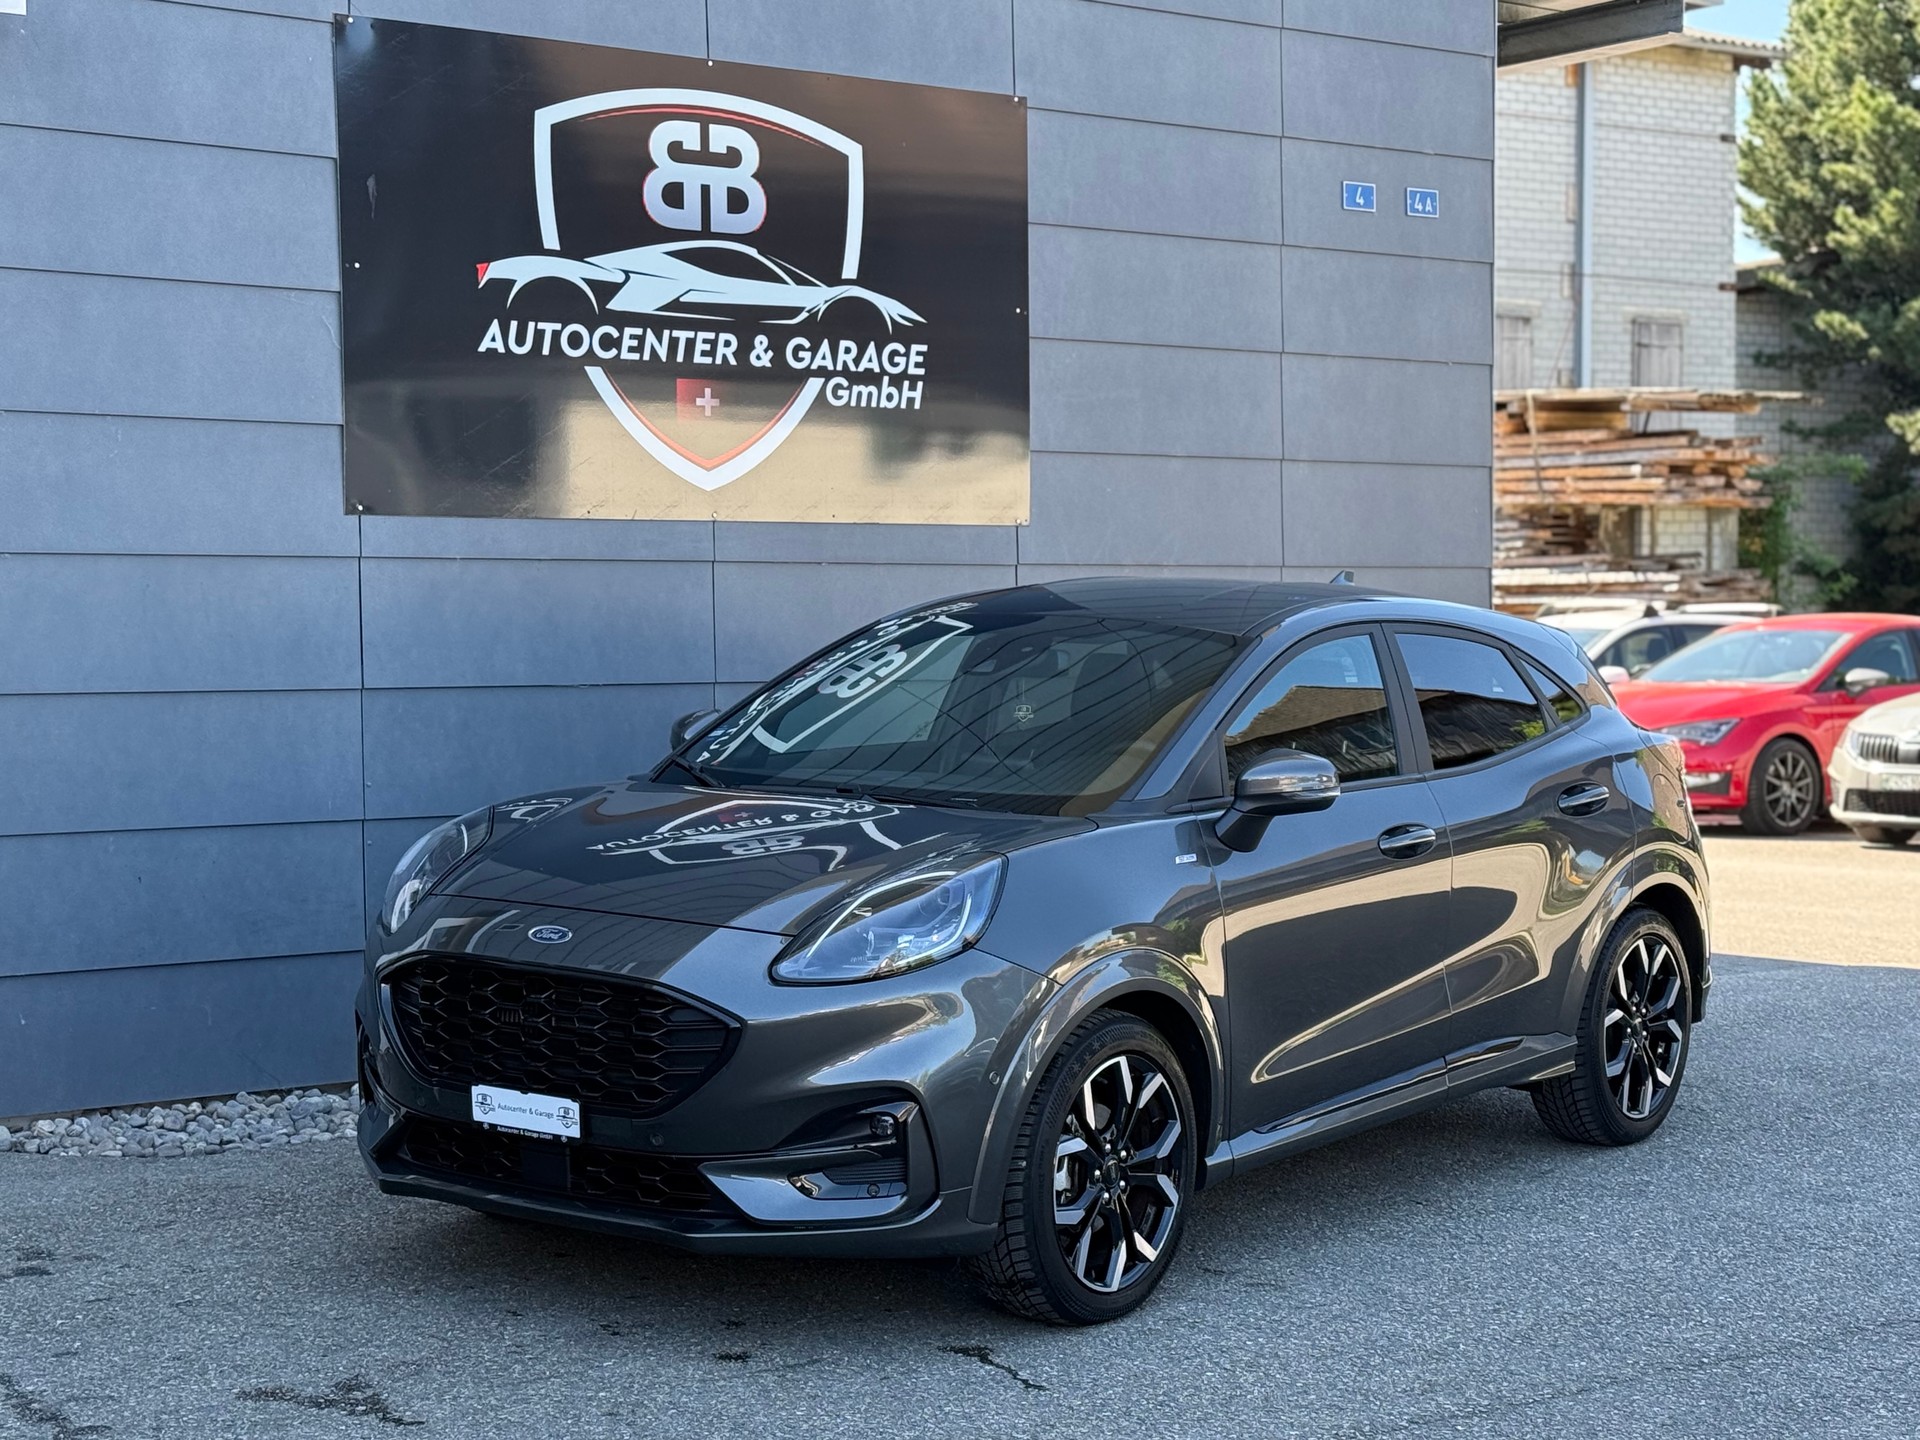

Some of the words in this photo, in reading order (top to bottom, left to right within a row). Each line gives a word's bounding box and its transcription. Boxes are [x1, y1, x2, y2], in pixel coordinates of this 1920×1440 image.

[1355, 186, 1365, 206] 4
[1414, 193, 1433, 213] 4A
[477, 318, 738, 366] AUTOCENTER
[749, 334, 774, 368] &
[785, 336, 928, 375] GARAGE
[826, 375, 924, 410] GmbH
[497, 1102, 528, 1114] Autocenter
[535, 1108, 555, 1120] Garage
